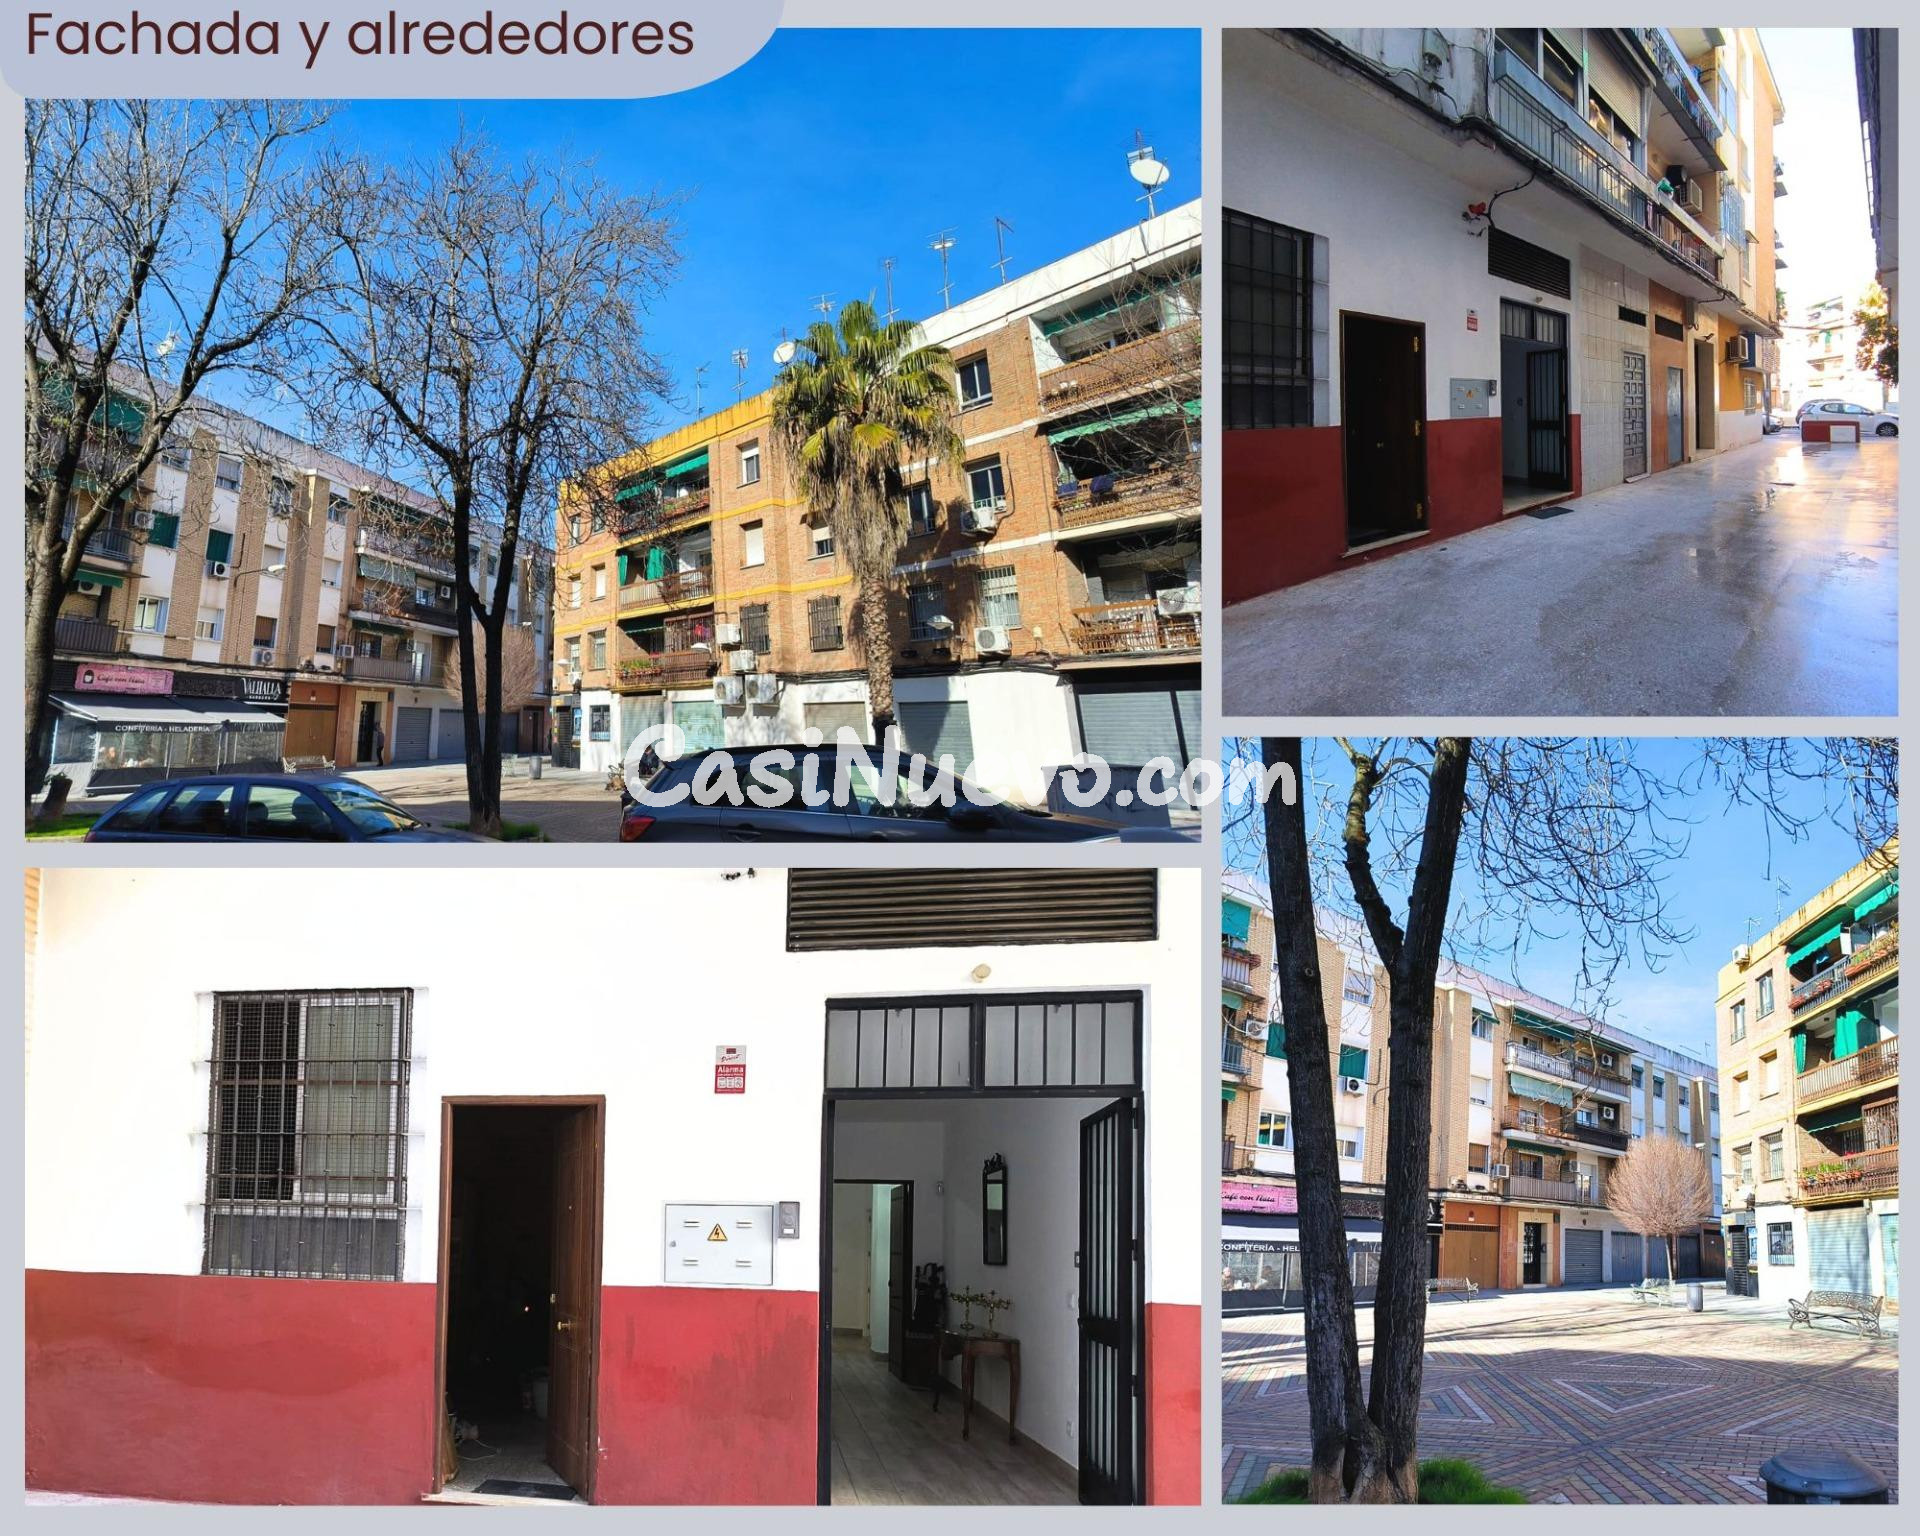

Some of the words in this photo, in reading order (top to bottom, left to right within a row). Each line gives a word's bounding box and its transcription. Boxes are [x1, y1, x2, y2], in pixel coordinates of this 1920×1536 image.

[241, 678, 281, 697] VALHALLA
[717, 1065, 744, 1073] Alarma
[1222, 1244, 1275, 1252] ONFITERÍA
